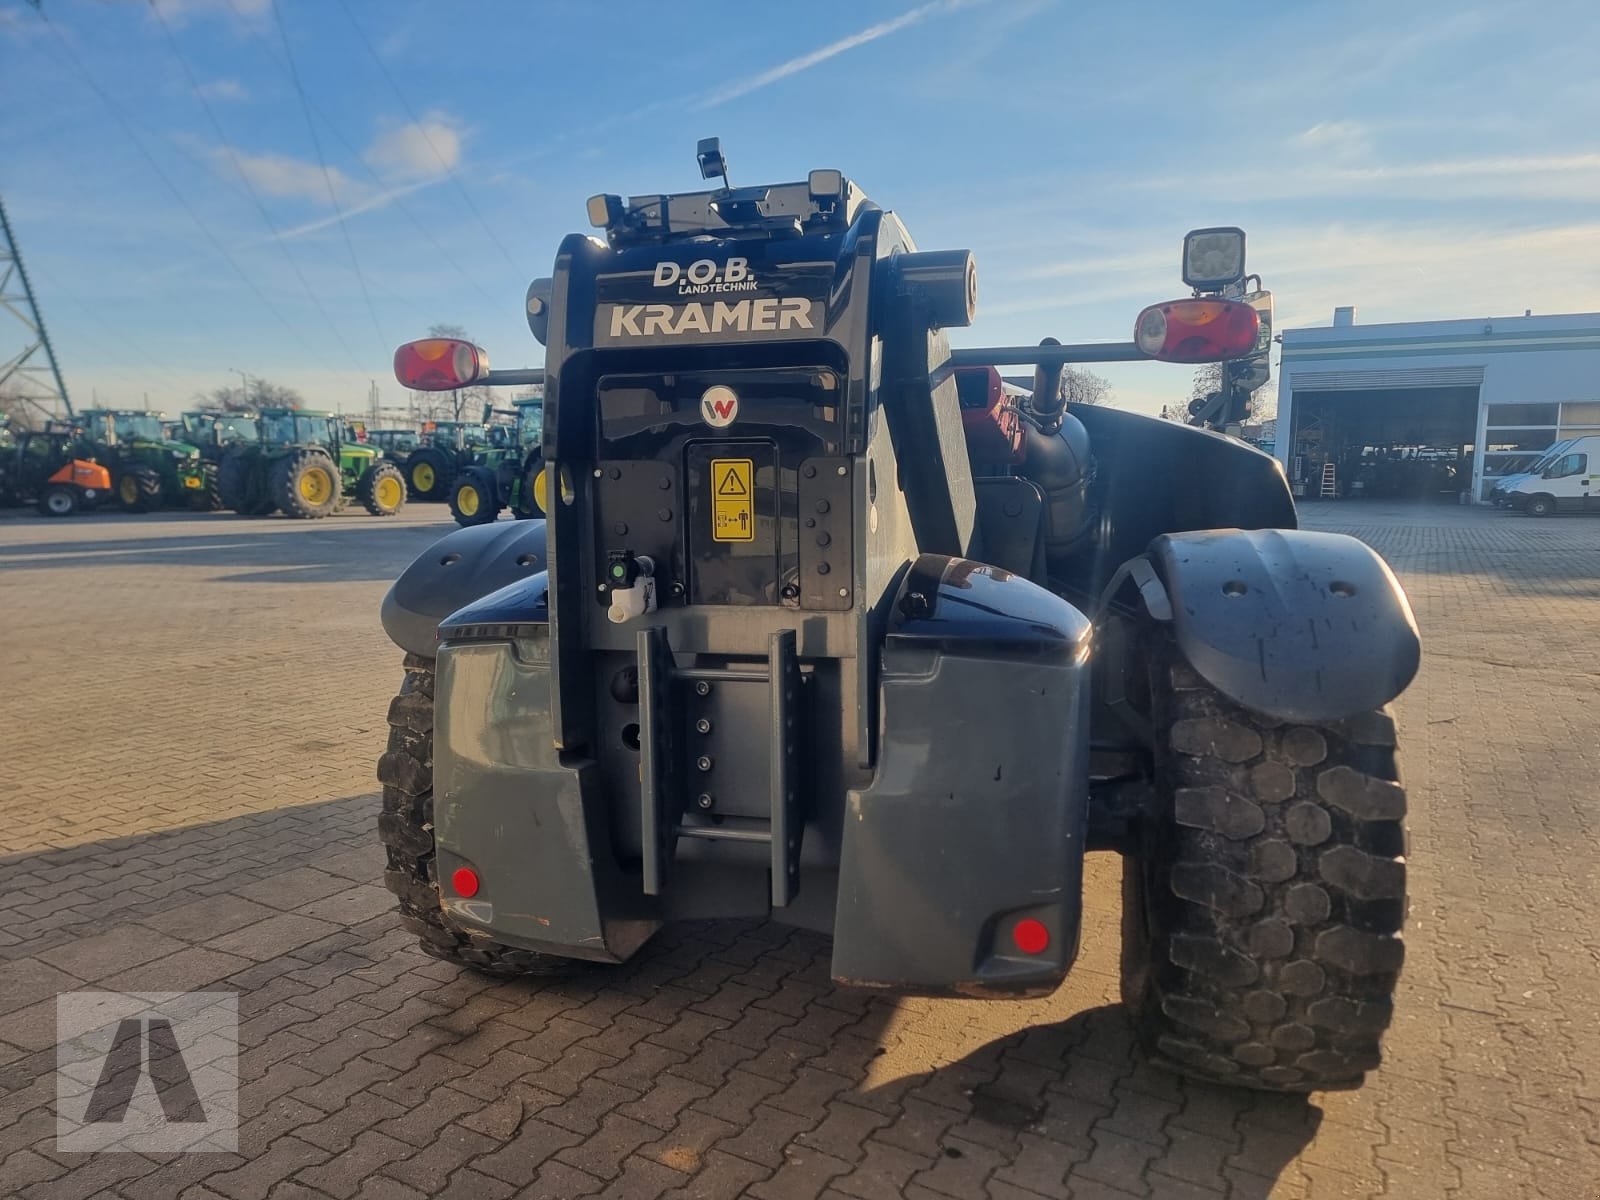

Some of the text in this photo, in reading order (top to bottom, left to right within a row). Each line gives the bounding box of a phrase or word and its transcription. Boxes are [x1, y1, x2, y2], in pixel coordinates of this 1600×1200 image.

[653, 257, 755, 287] D.O.B.
[678, 281, 758, 295] LANDTECHNIK
[610, 297, 814, 337] KRAMER
